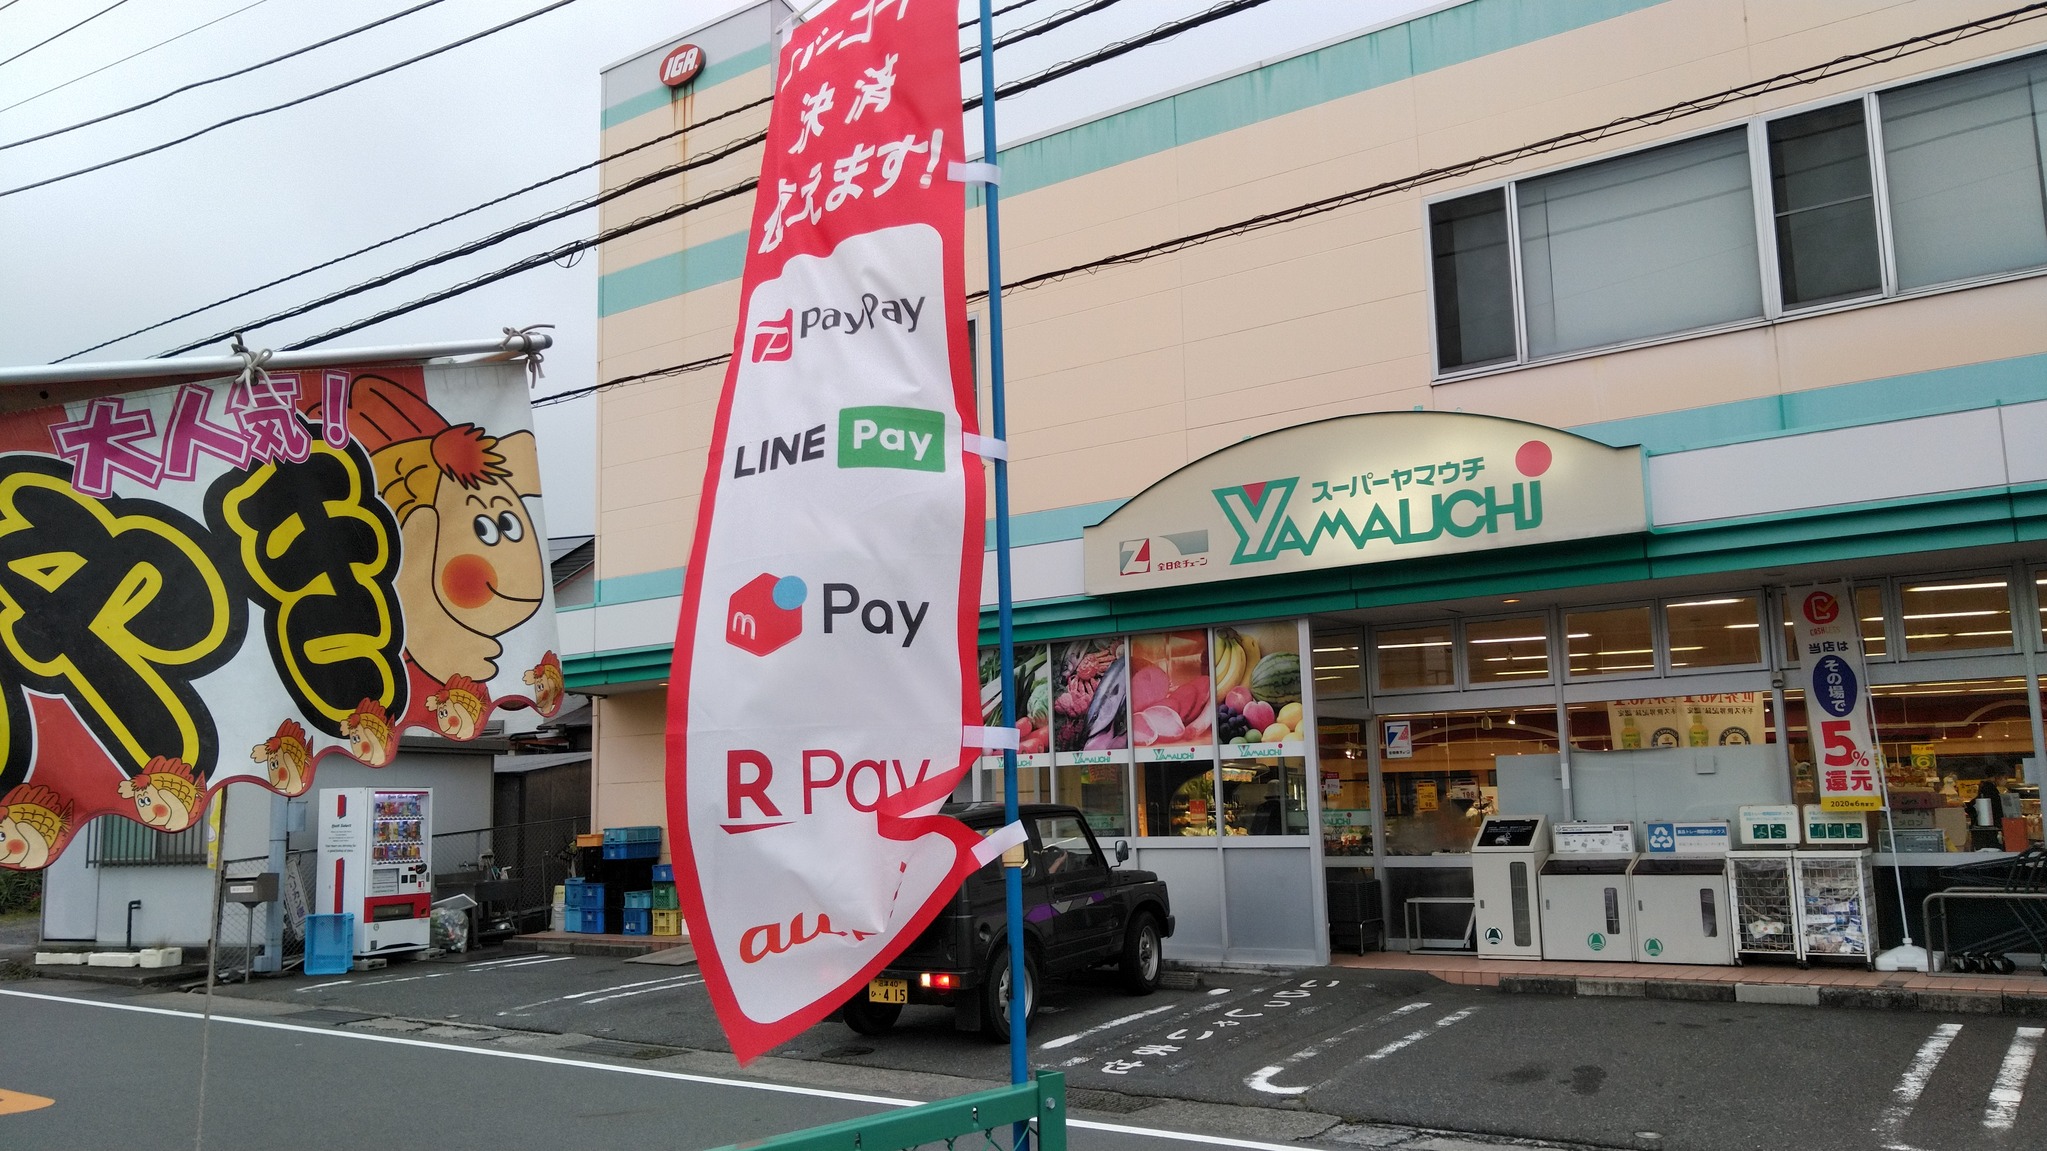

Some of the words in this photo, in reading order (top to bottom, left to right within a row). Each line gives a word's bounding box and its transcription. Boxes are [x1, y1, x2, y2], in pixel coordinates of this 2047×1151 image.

[663, 47, 698, 81] IGA
[781, 0, 909, 93] バーコー
[800, 293, 925, 338] PayPay
[734, 423, 826, 479] LINE
[853, 418, 933, 462] Pay
[1311, 456, 1486, 504] スーパーヤマウチ
[1157, 556, 1208, 572] 全日食チェーン
[823, 583, 930, 647] Pay
[1809, 641, 1849, 655] 当店は
[1825, 659, 1846, 712] その場で
[1821, 720, 1870, 767] 5%
[728, 749, 783, 818] R
[1825, 770, 1873, 791] 還元
[1101, 979, 1341, 1075] いらっしゃいませ
